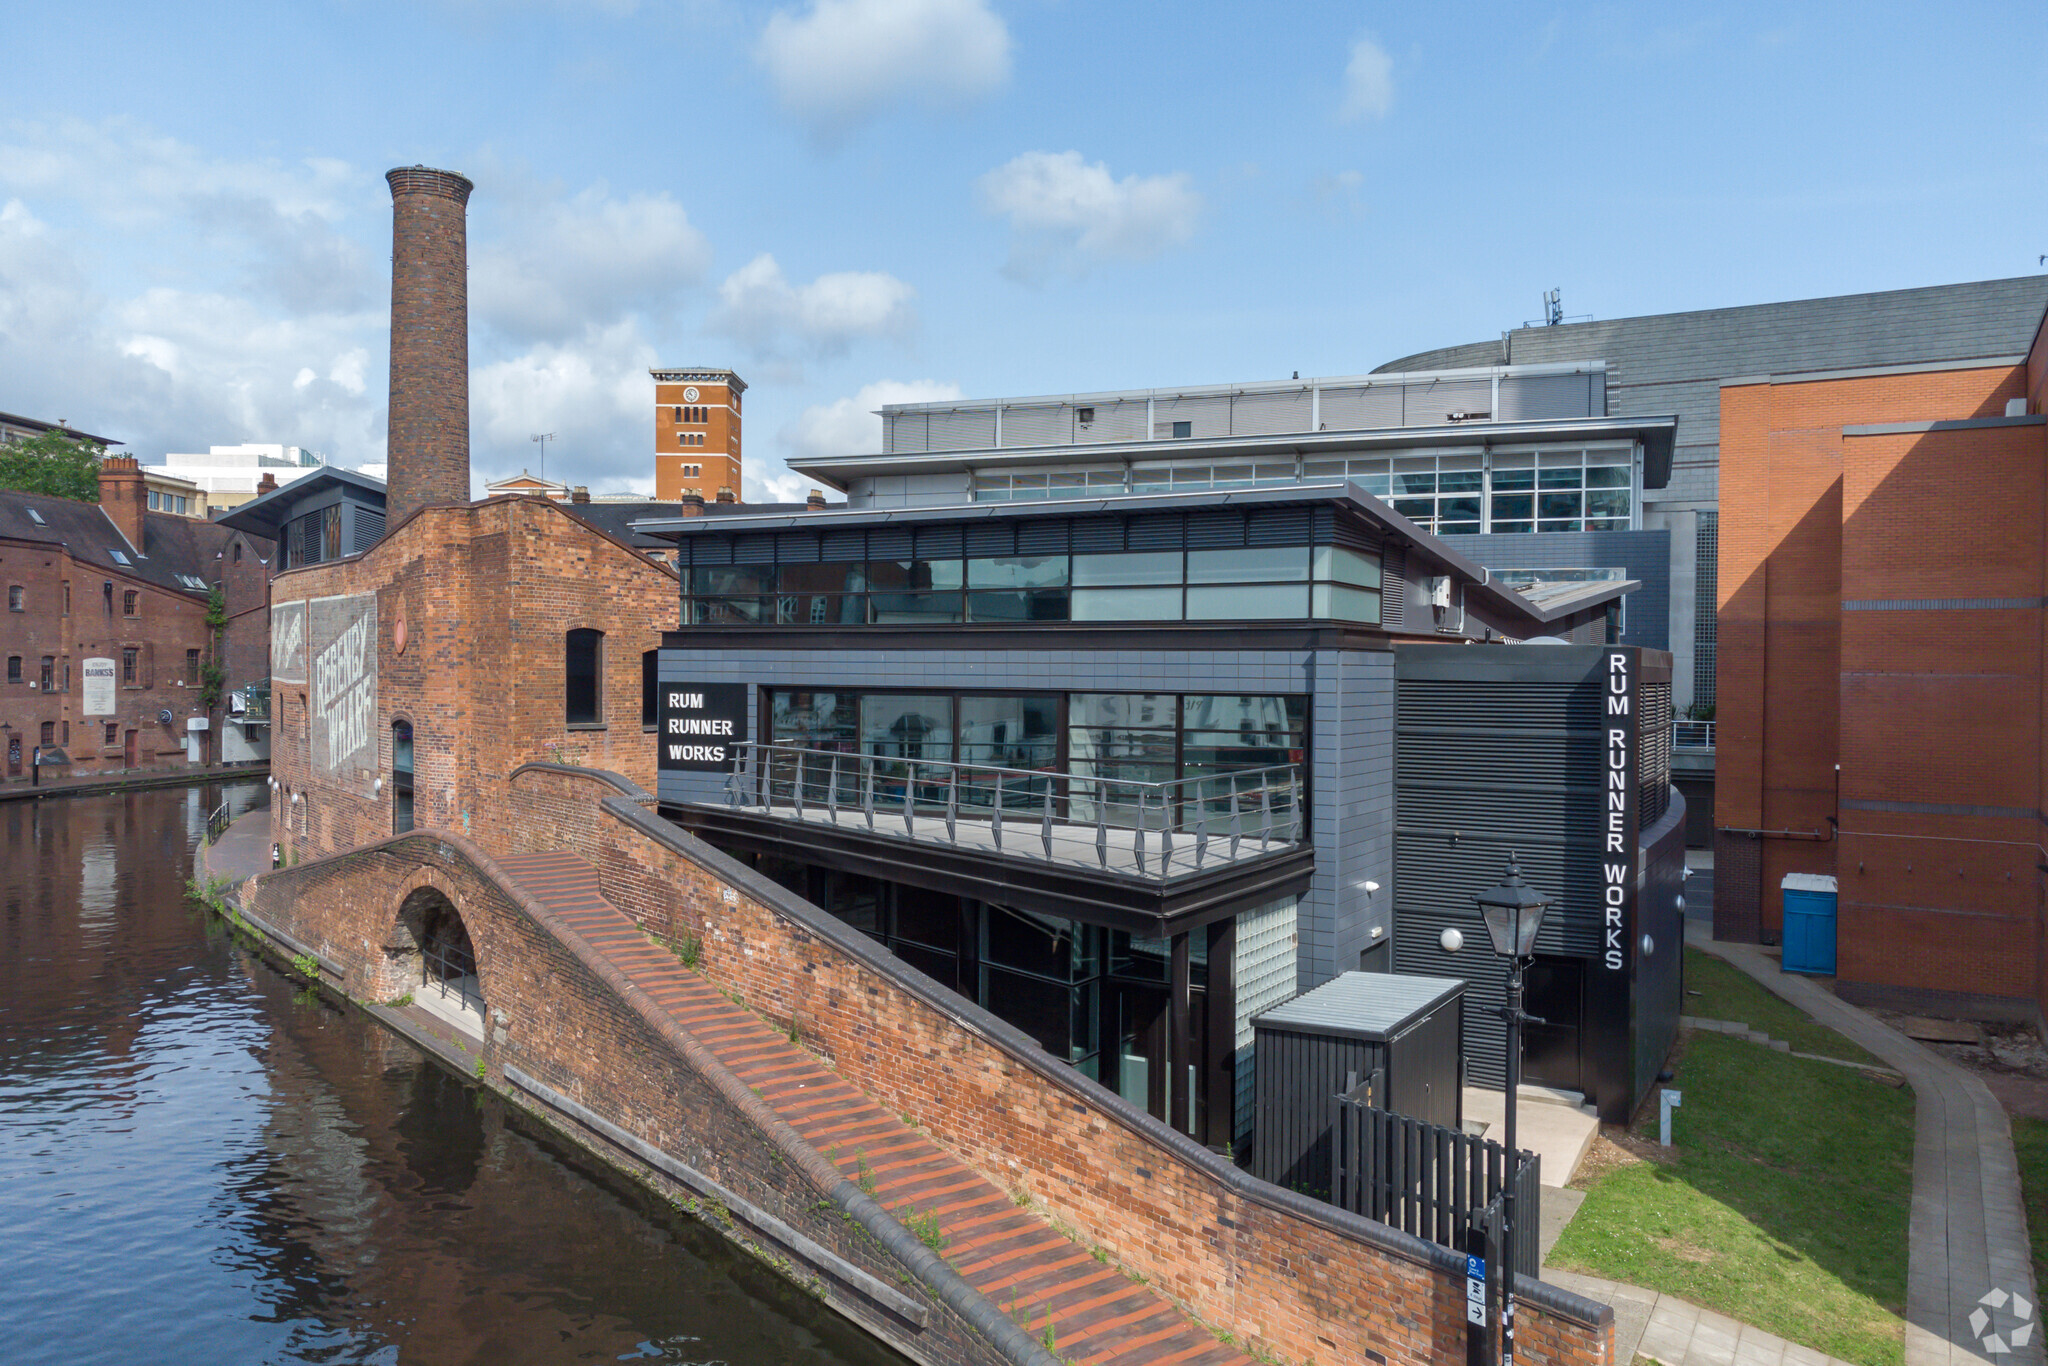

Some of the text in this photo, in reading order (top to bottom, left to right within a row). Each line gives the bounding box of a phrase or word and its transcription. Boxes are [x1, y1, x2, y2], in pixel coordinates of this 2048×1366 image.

[316, 612, 368, 719] REGENCY
[327, 672, 371, 770] WHARF
[668, 693, 704, 709] RUM
[668, 719, 734, 736] RUNNER
[668, 745, 726, 762] WORKS
[1604, 654, 1629, 970] RUM RUNNER WORKS
